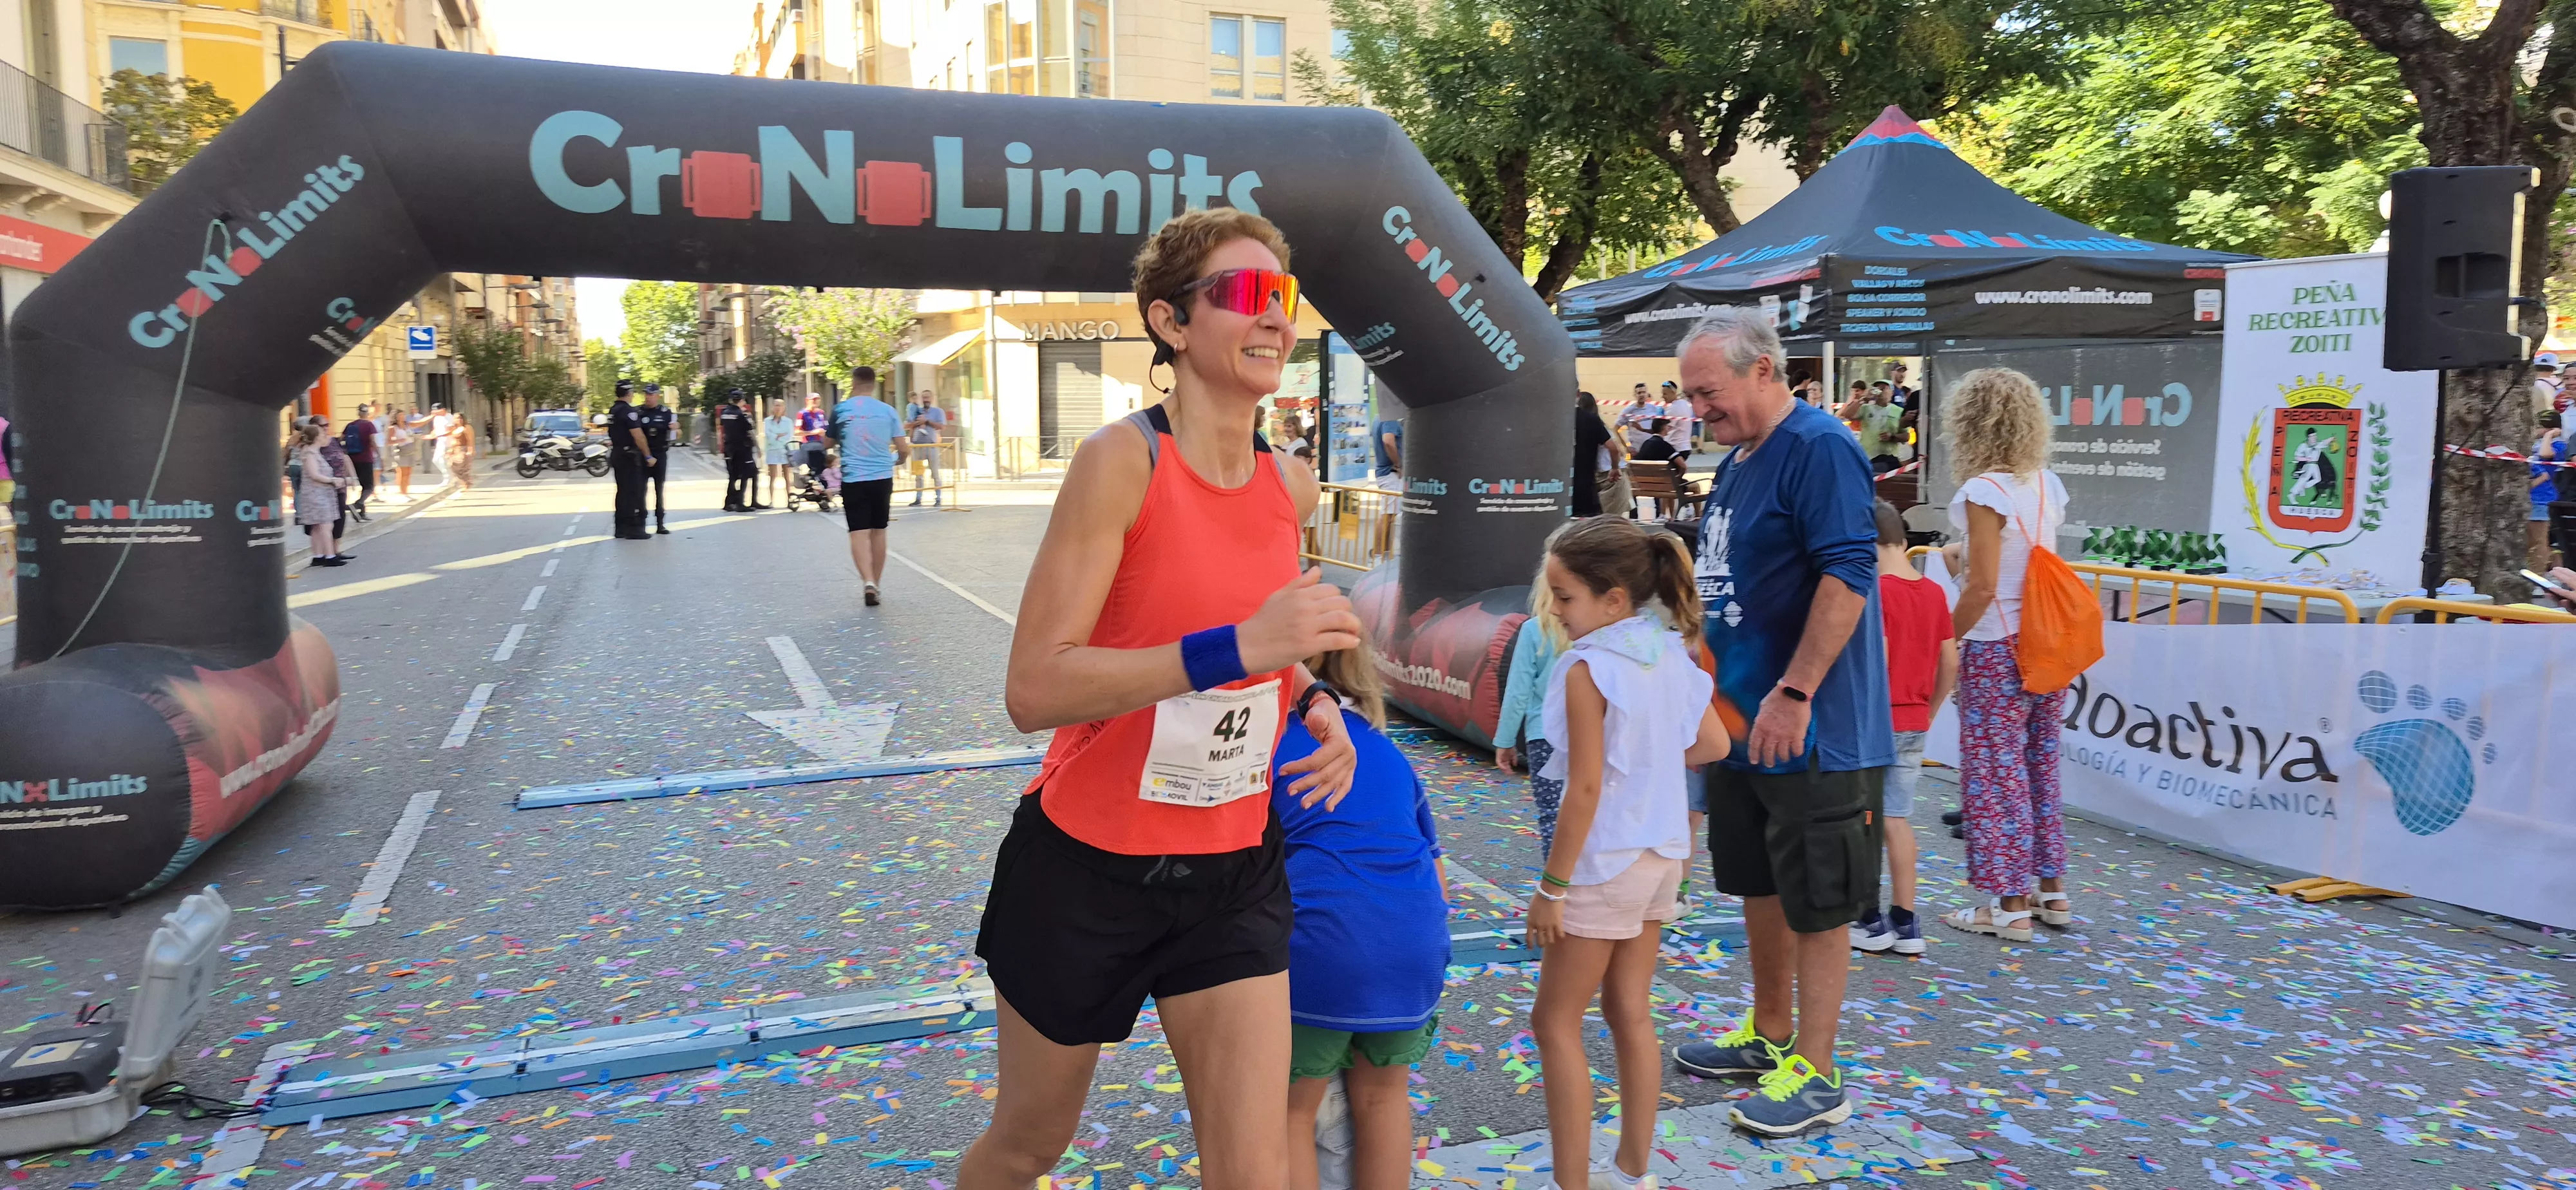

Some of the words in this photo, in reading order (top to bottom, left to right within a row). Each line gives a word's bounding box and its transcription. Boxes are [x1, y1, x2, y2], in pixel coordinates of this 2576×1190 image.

[1975, 287, 2153, 305] www.cronolimits.com
[2292, 280, 2357, 305] PEÑA
[2248, 307, 2385, 330] RECREATIV
[1020, 320, 1119, 341] MANGO
[2289, 333, 2353, 354] ZOITI
[1213, 706, 1251, 742] 42
[2061, 672, 2339, 783] doactiva
[1208, 744, 1244, 762] MARTA
[1152, 777, 1192, 790] embou
[2060, 743, 2127, 778] LOGÍA
[2138, 764, 2152, 783] Y
[2157, 770, 2338, 820] BIOMECÁNICA
